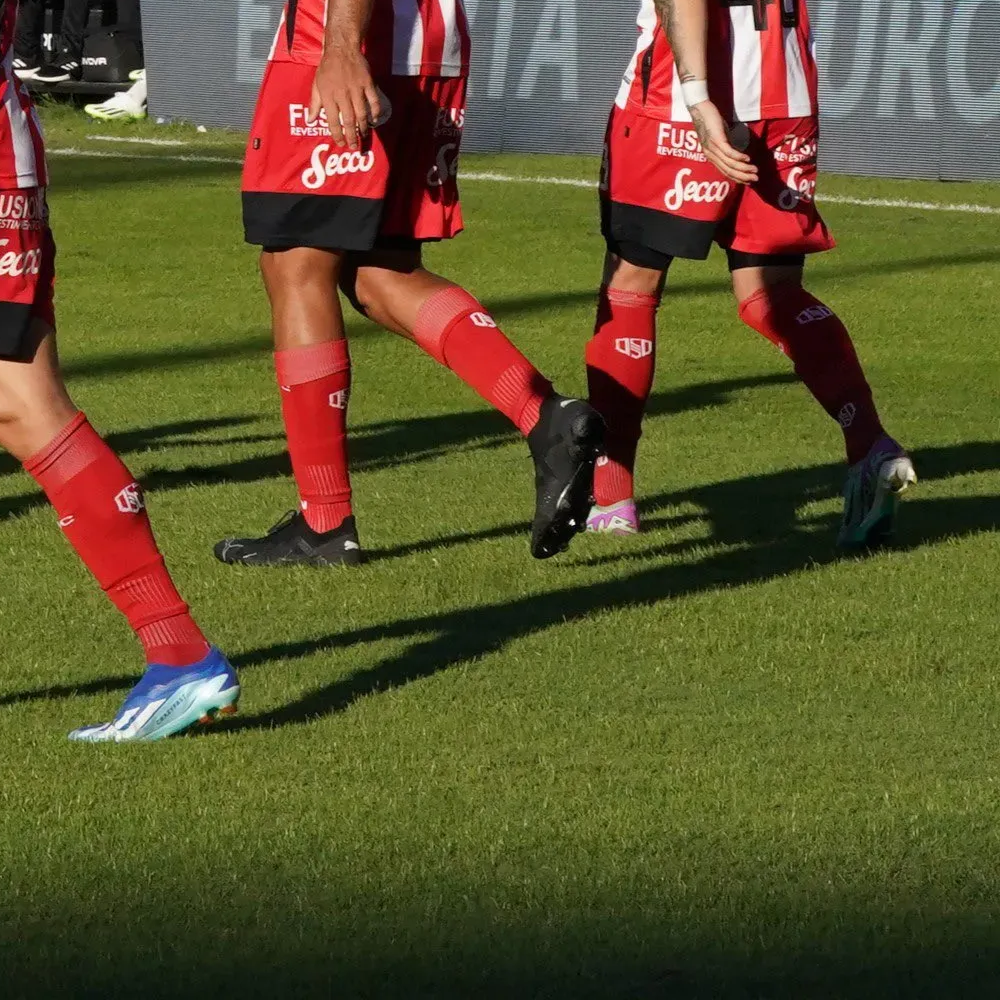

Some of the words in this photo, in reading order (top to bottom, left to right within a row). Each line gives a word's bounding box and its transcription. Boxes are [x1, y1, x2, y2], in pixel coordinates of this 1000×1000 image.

[289, 103, 328, 128] FUS
[657, 123, 702, 152] FUS
[302, 143, 375, 189] Secco
[664, 168, 730, 211] Secco
[777, 167, 816, 210] Sec
